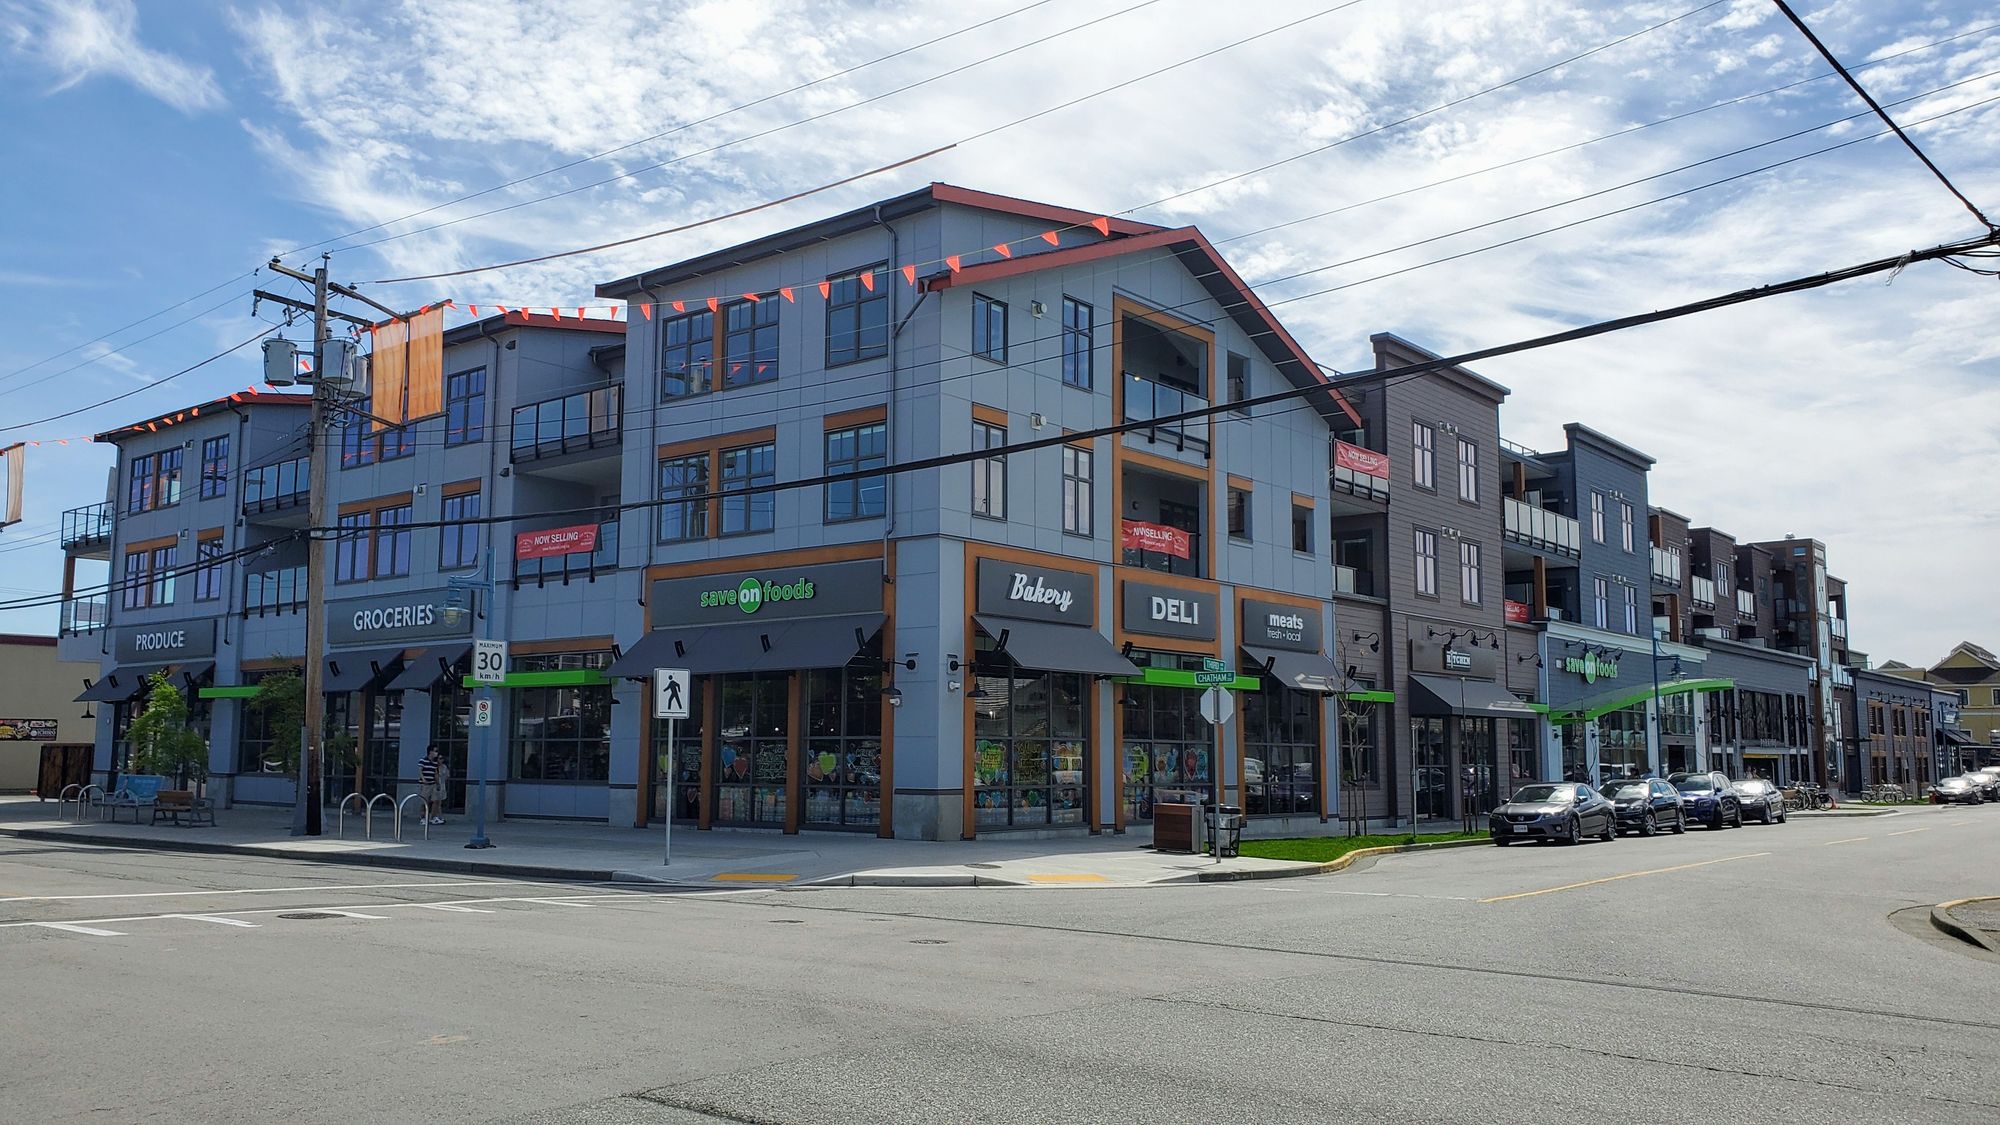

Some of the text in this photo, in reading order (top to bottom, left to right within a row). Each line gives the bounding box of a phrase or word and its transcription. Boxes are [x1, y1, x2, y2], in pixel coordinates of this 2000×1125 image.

[1360, 453, 1378, 465] SELLING
[534, 535, 550, 545] NOW
[551, 531, 579, 543] SELLING
[1145, 527, 1173, 541] SELLING
[700, 577, 815, 608] save on foods
[1010, 572, 1073, 612] Bakery
[353, 603, 434, 631] GROCERIES
[1151, 596, 1199, 625] DELI
[1269, 613, 1304, 630] meats
[135, 630, 185, 651] PRODUCE
[1267, 627, 1302, 642] fresh local
[477, 651, 503, 671] 30
[1565, 656, 1618, 678] save on foods
[479, 672, 500, 680] km/h
[1197, 673, 1227, 682] CHATHAM
